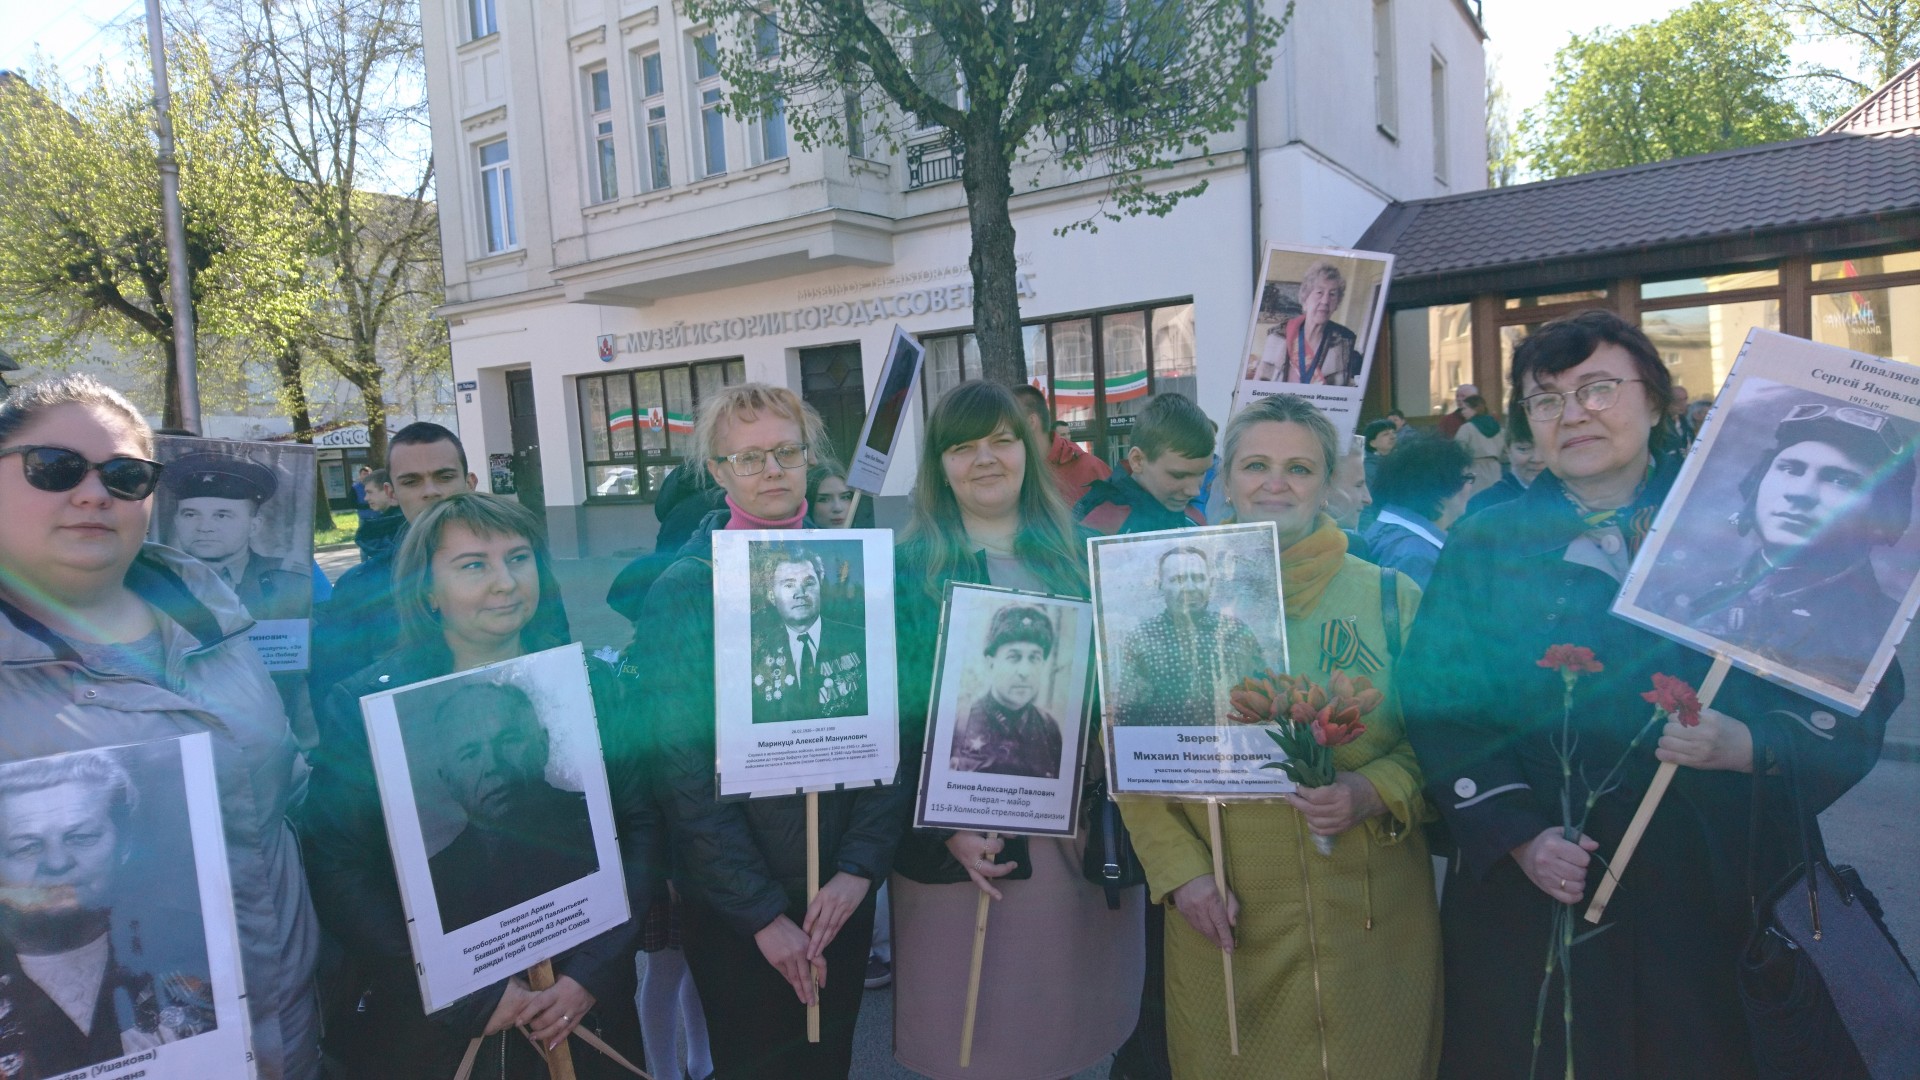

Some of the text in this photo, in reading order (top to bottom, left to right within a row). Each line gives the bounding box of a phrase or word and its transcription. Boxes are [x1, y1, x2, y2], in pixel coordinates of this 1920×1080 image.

[797, 283, 848, 301] MUSEUM
[849, 279, 867, 294] OF
[868, 276, 893, 290] THE
[894, 264, 947, 285] HISTORY
[626, 272, 1037, 354] МУЗЕЙ ИСТОРИИ ГОРОДА СОВЕТА
[1811, 368, 1860, 389] Сергей
[1850, 358, 1920, 386] Поваляев
[1316, 394, 1348, 402] Ивановна
[1848, 395, 1890, 412] 1917-1947
[248, 633, 288, 641] тинович
[757, 734, 868, 748] Марикуца Алексей Мануилович
[1177, 733, 1220, 745] Зверев
[1133, 751, 1272, 763] Михаил Никифорович
[946, 781, 1056, 797] Блинов Александр Павлович
[970, 794, 1000, 805] Генерал
[1006, 797, 1031, 807] майор
[930, 803, 1065, 820] 115-й Холмской стрелковой дивизии
[499, 901, 555, 929] Генерал Армии
[463, 897, 589, 955] Белобородов Афанасий Павлантьевич
[474, 908, 585, 961] Бывший командир 43 Армией,
[473, 917, 591, 976] дважды Герой Советского Союза
[91, 1049, 157, 1078] (Ушакова)
